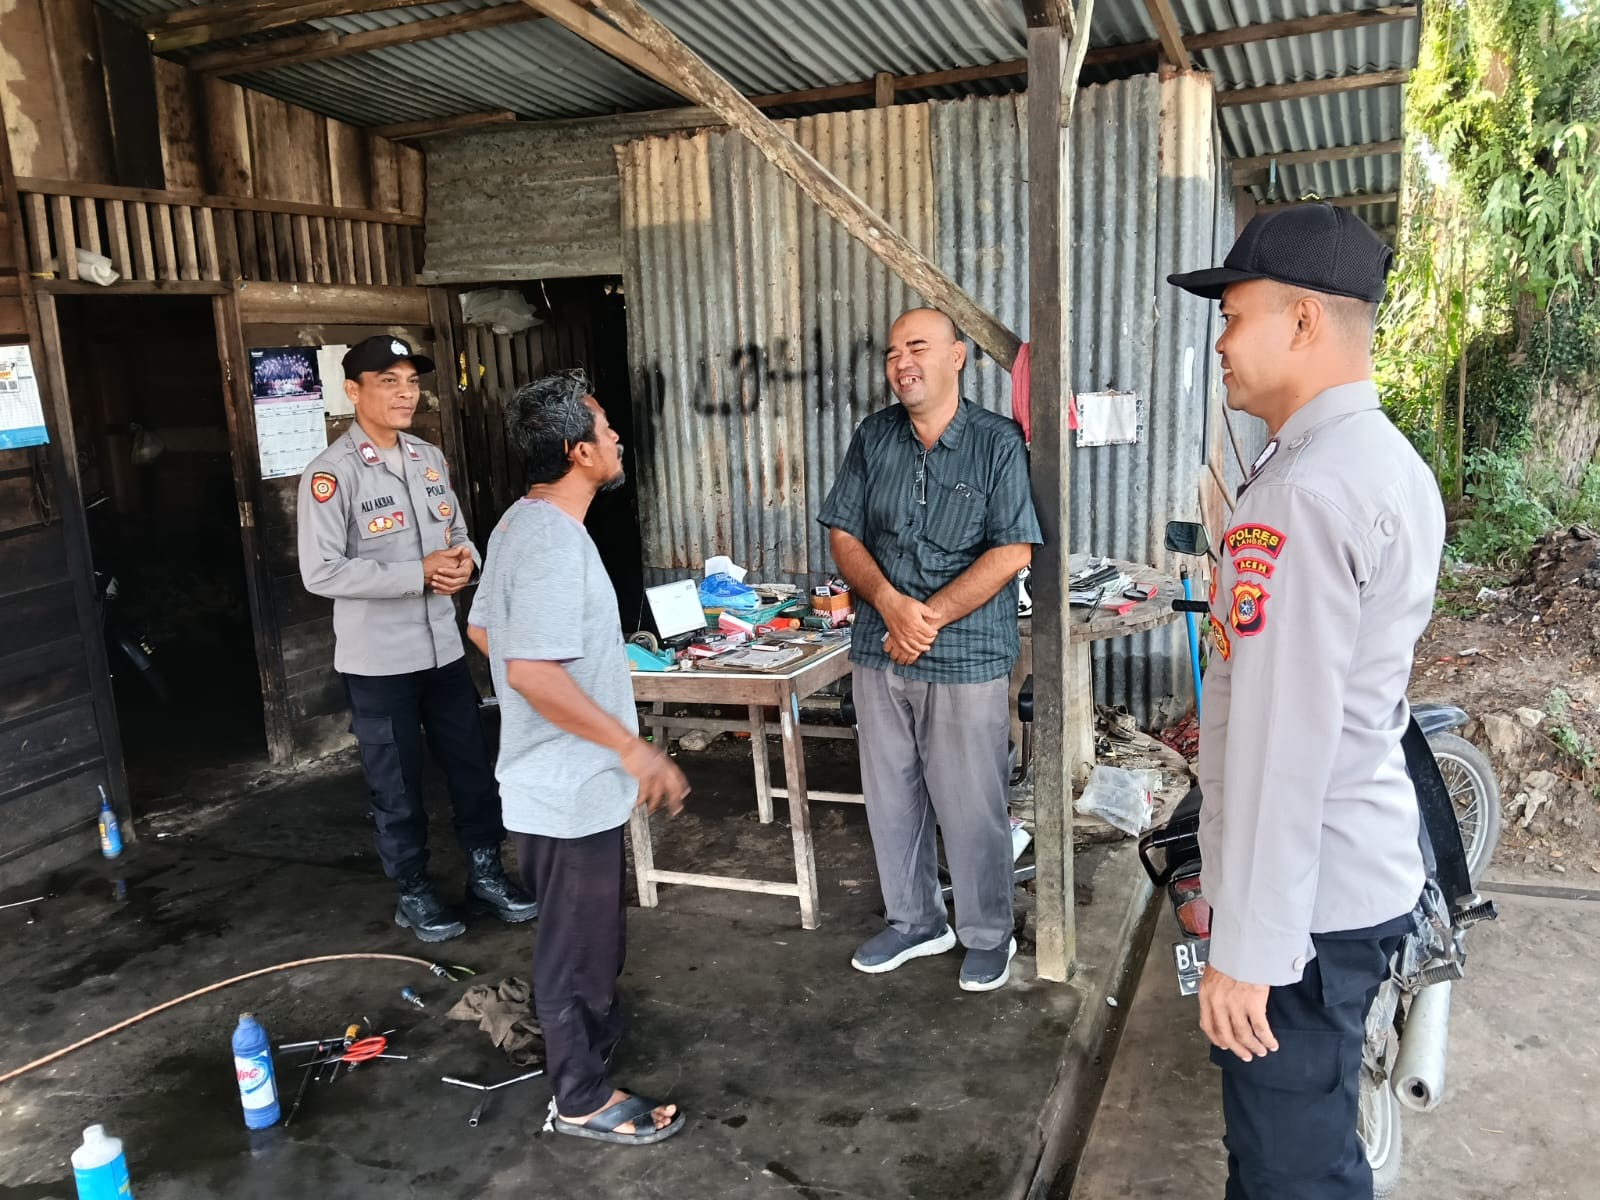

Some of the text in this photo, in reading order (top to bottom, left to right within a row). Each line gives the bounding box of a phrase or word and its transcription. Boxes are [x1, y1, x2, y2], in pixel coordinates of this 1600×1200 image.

[361, 500, 373, 512] ALI
[1229, 528, 1279, 546] POLRES
[1237, 538, 1267, 548] LANGSA
[1240, 560, 1267, 573] ACEH
[1175, 943, 1205, 970] BL
